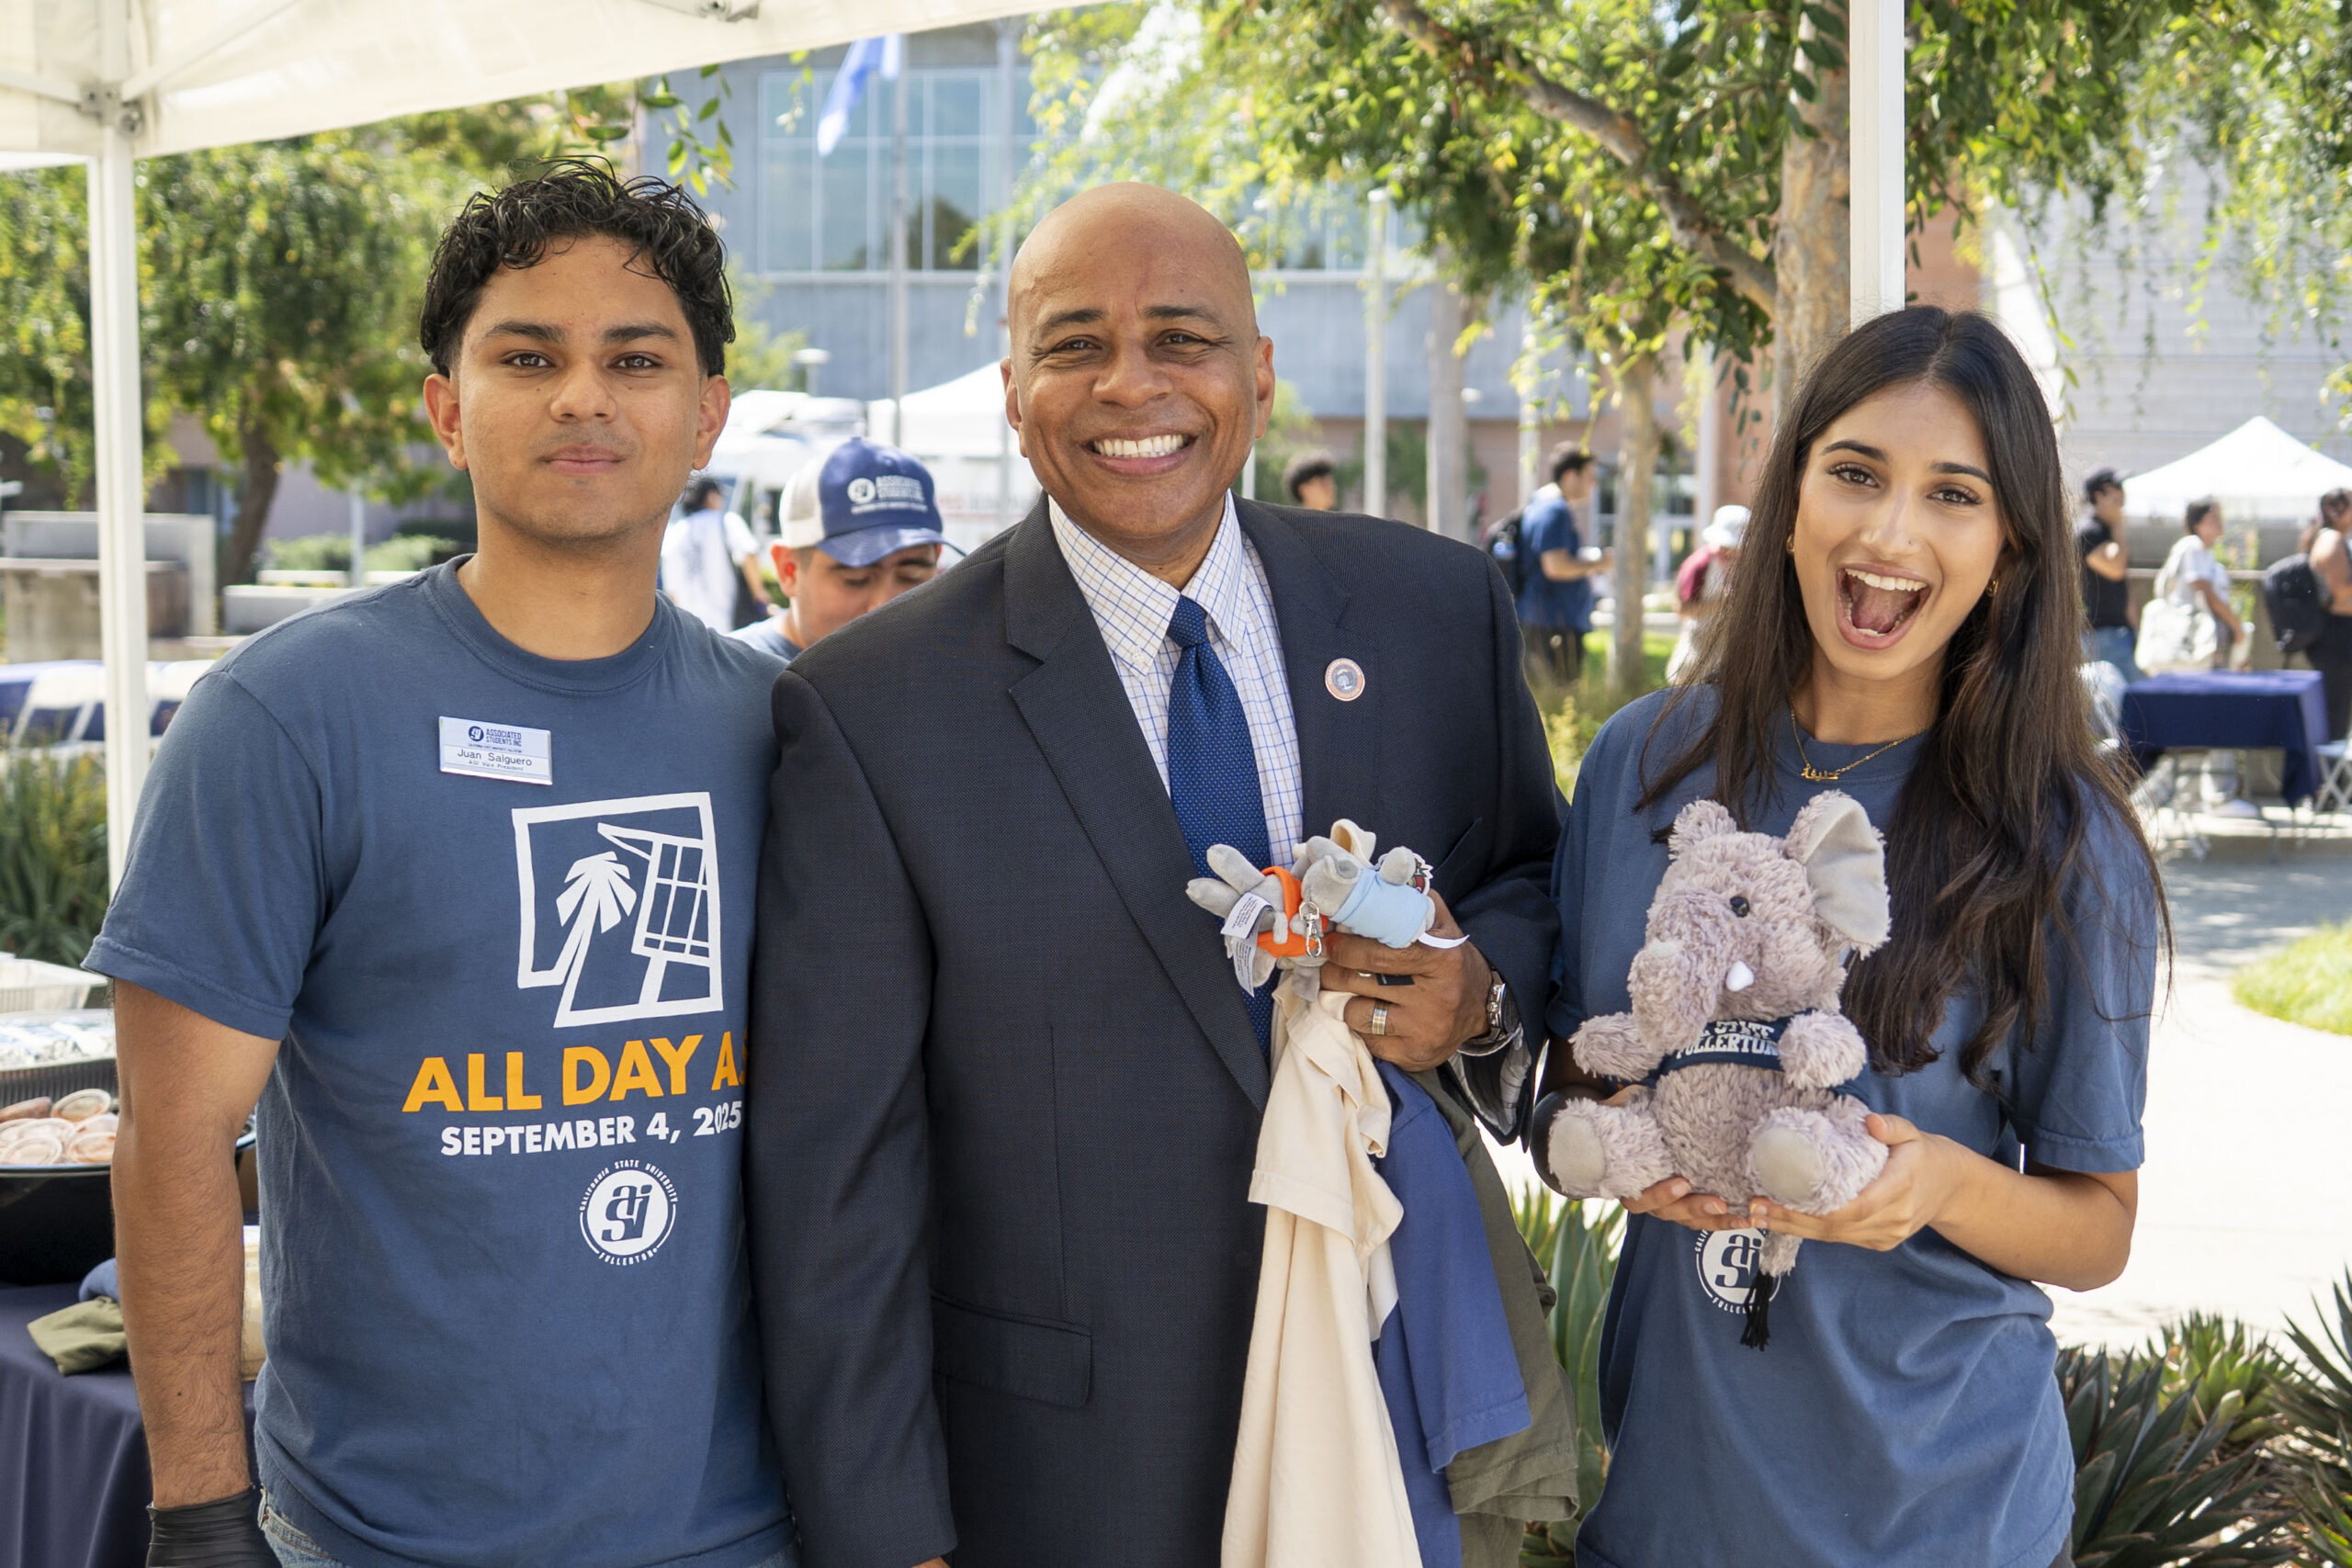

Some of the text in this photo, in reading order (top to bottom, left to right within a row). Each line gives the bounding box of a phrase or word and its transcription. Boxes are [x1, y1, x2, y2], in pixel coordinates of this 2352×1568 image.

[486, 728, 522, 739] ASSOCIATED
[486, 736, 512, 745] STUDENTS
[458, 749, 532, 766] Juan Salguero
[401, 1026, 748, 1112] ALL DAY A
[441, 1100, 742, 1156] SEPTEMBER 4, 2025
[579, 1159, 678, 1212] CALIFORNIA STATE UNIVERSITY
